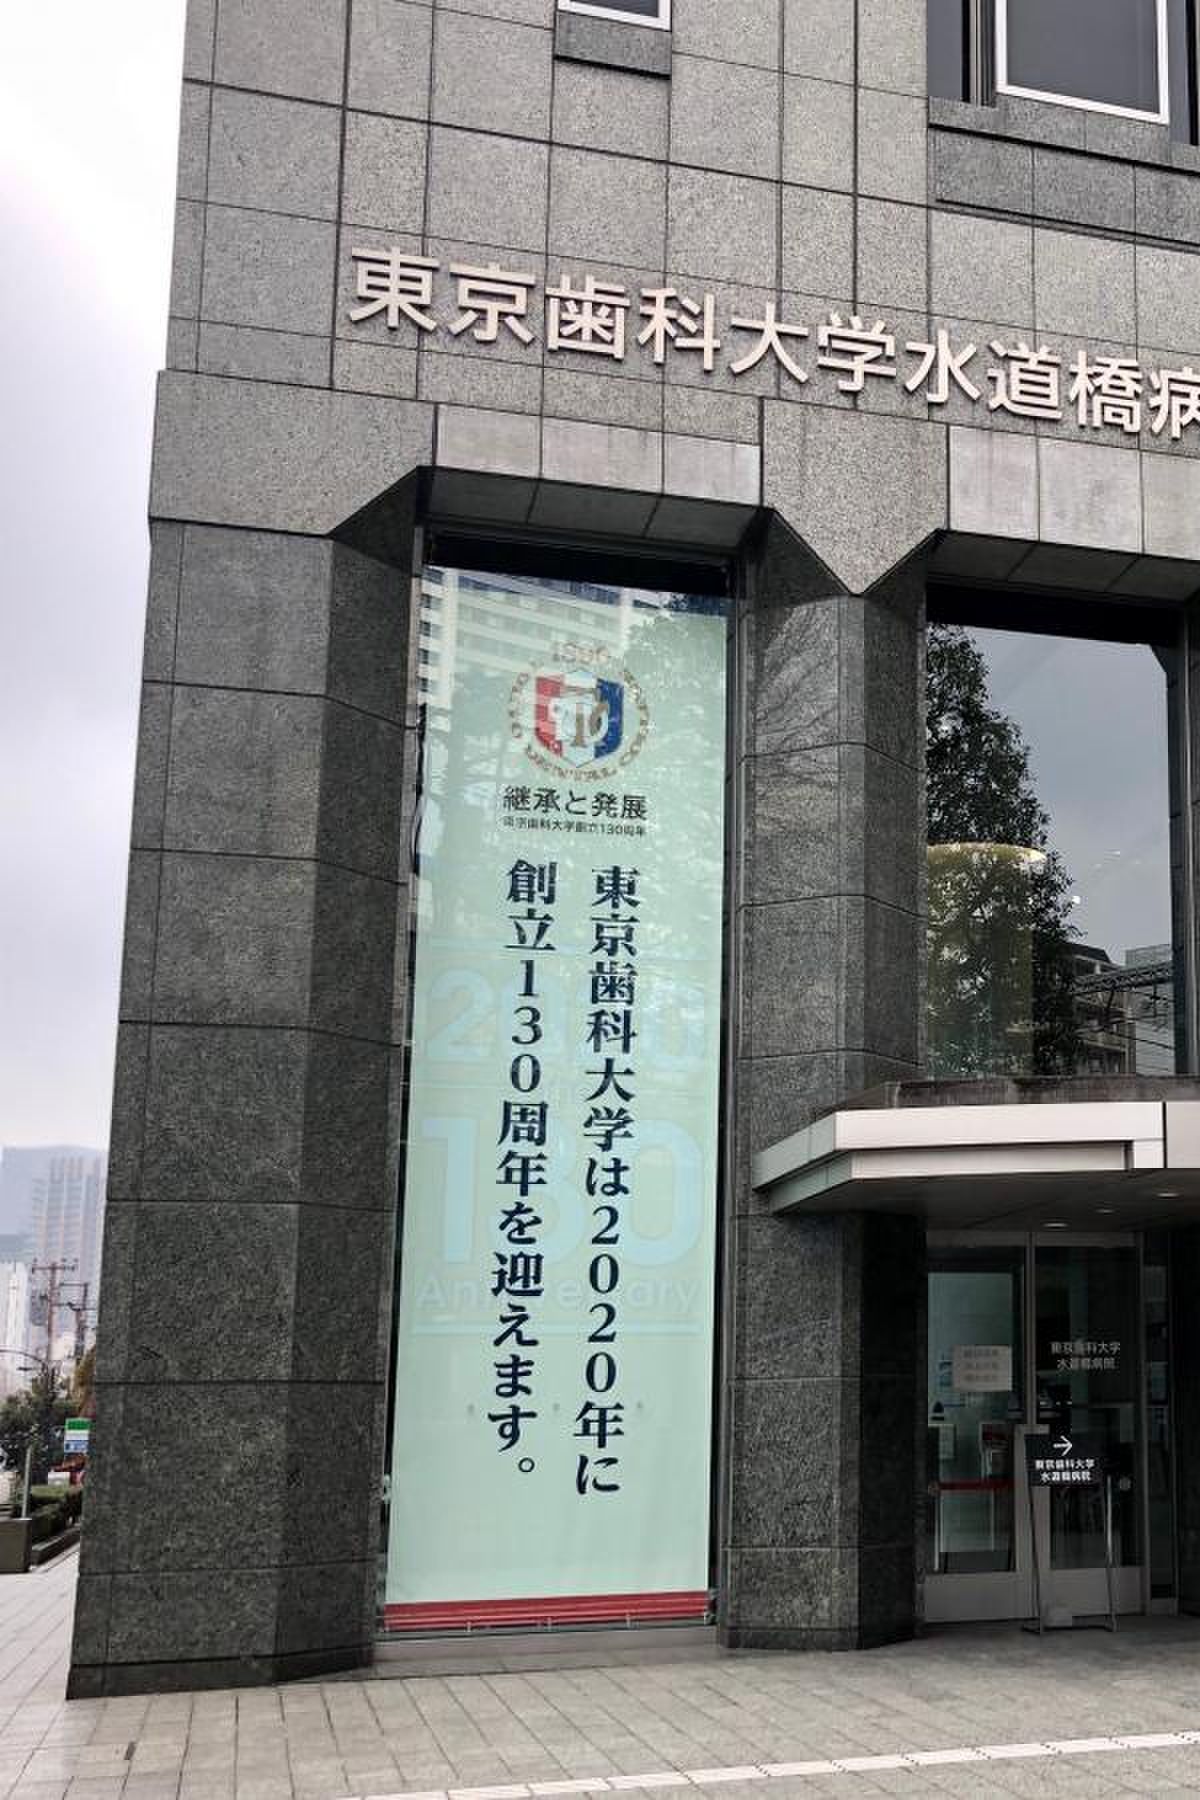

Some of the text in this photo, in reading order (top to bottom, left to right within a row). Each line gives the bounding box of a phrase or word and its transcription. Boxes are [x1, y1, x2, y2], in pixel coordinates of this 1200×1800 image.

[503, 786, 648, 820] 継承と発展
[488, 858, 557, 1474] 創立130周年を迎えます。
[573, 866, 641, 1495] 東京歯科大学は2020年に
